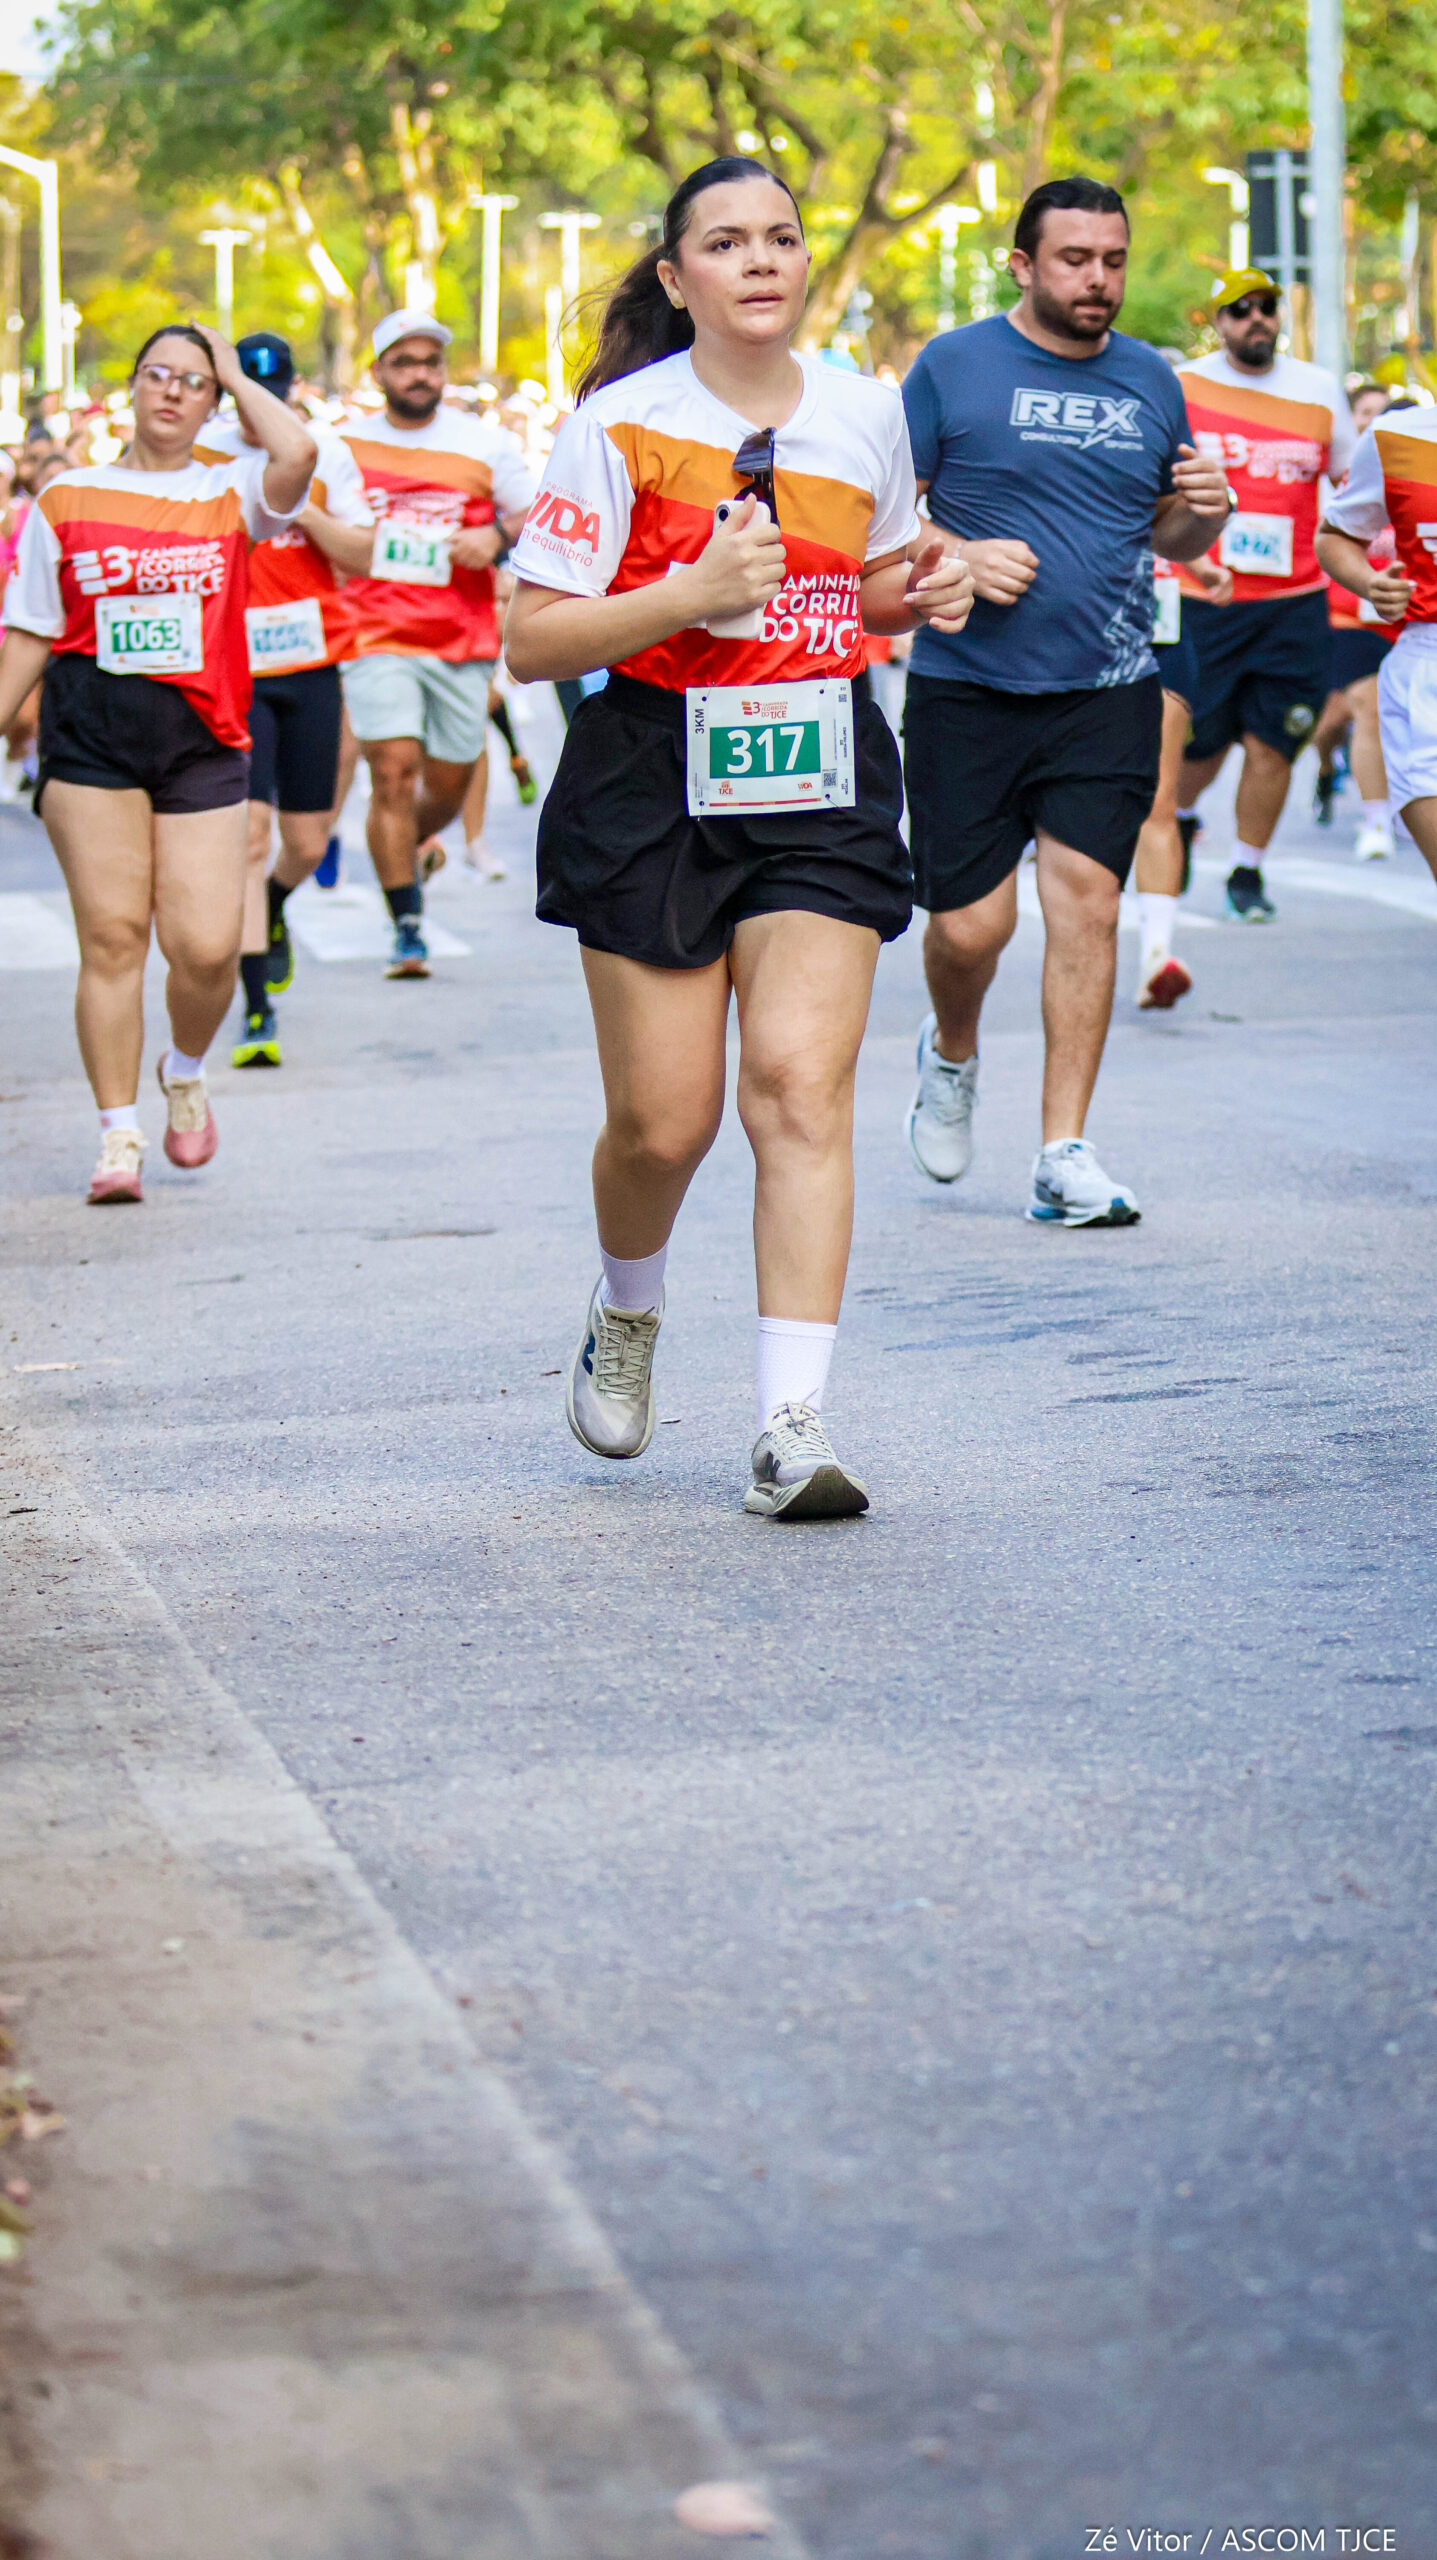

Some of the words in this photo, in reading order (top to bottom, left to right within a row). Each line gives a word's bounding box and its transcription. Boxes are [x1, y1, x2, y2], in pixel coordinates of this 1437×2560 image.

[1010, 388, 1143, 437] REX
[137, 574, 170, 594] DO
[113, 620, 180, 650] 1063
[759, 615, 799, 643] DO
[695, 708, 705, 734] 3KM
[770, 710, 786, 719] TJCE
[727, 725, 805, 775] 317
